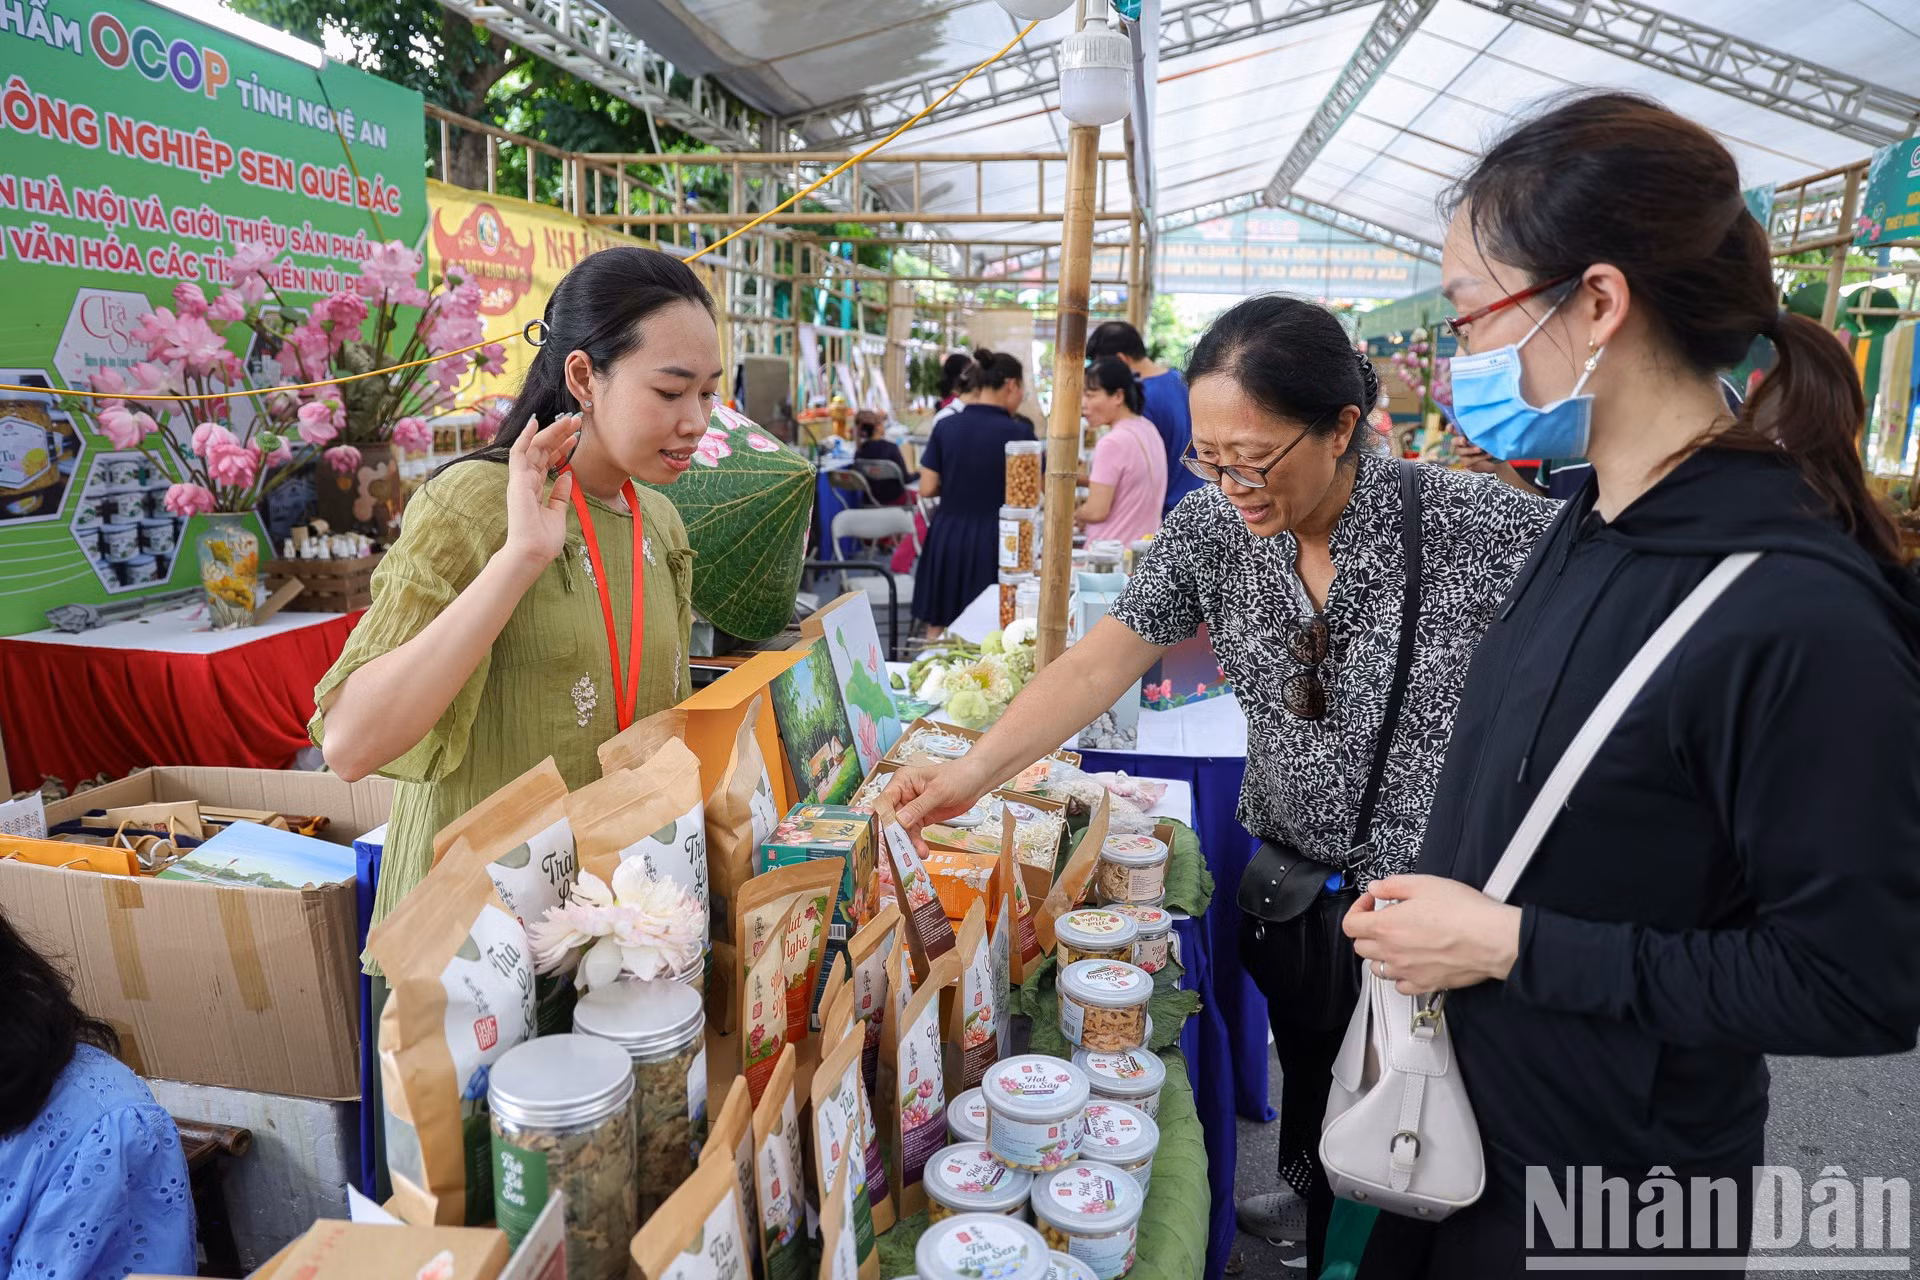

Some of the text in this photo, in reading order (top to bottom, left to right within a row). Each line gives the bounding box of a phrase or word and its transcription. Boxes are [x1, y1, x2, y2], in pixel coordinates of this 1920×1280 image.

[89, 12, 229, 98] OCOP
[236, 72, 292, 121] TỈNH
[298, 99, 355, 144] NGHỆ
[359, 120, 387, 149] AN
[0, 75, 401, 217] ÔNG NGHIỆP SEN QUÊ BÁC
[6, 221, 76, 267] VĂN
[80, 235, 146, 275] HÓA
[148, 242, 200, 279] CÁC
[21, 174, 72, 218] HÀ
[74, 185, 128, 233] NỘI
[130, 193, 170, 234] VÀ
[172, 203, 222, 240] GIỚI
[224, 216, 286, 252] THIỆU
[290, 220, 329, 257] SẢN
[542, 850, 574, 886] Trà
[991, 1245, 1017, 1259] Sen
